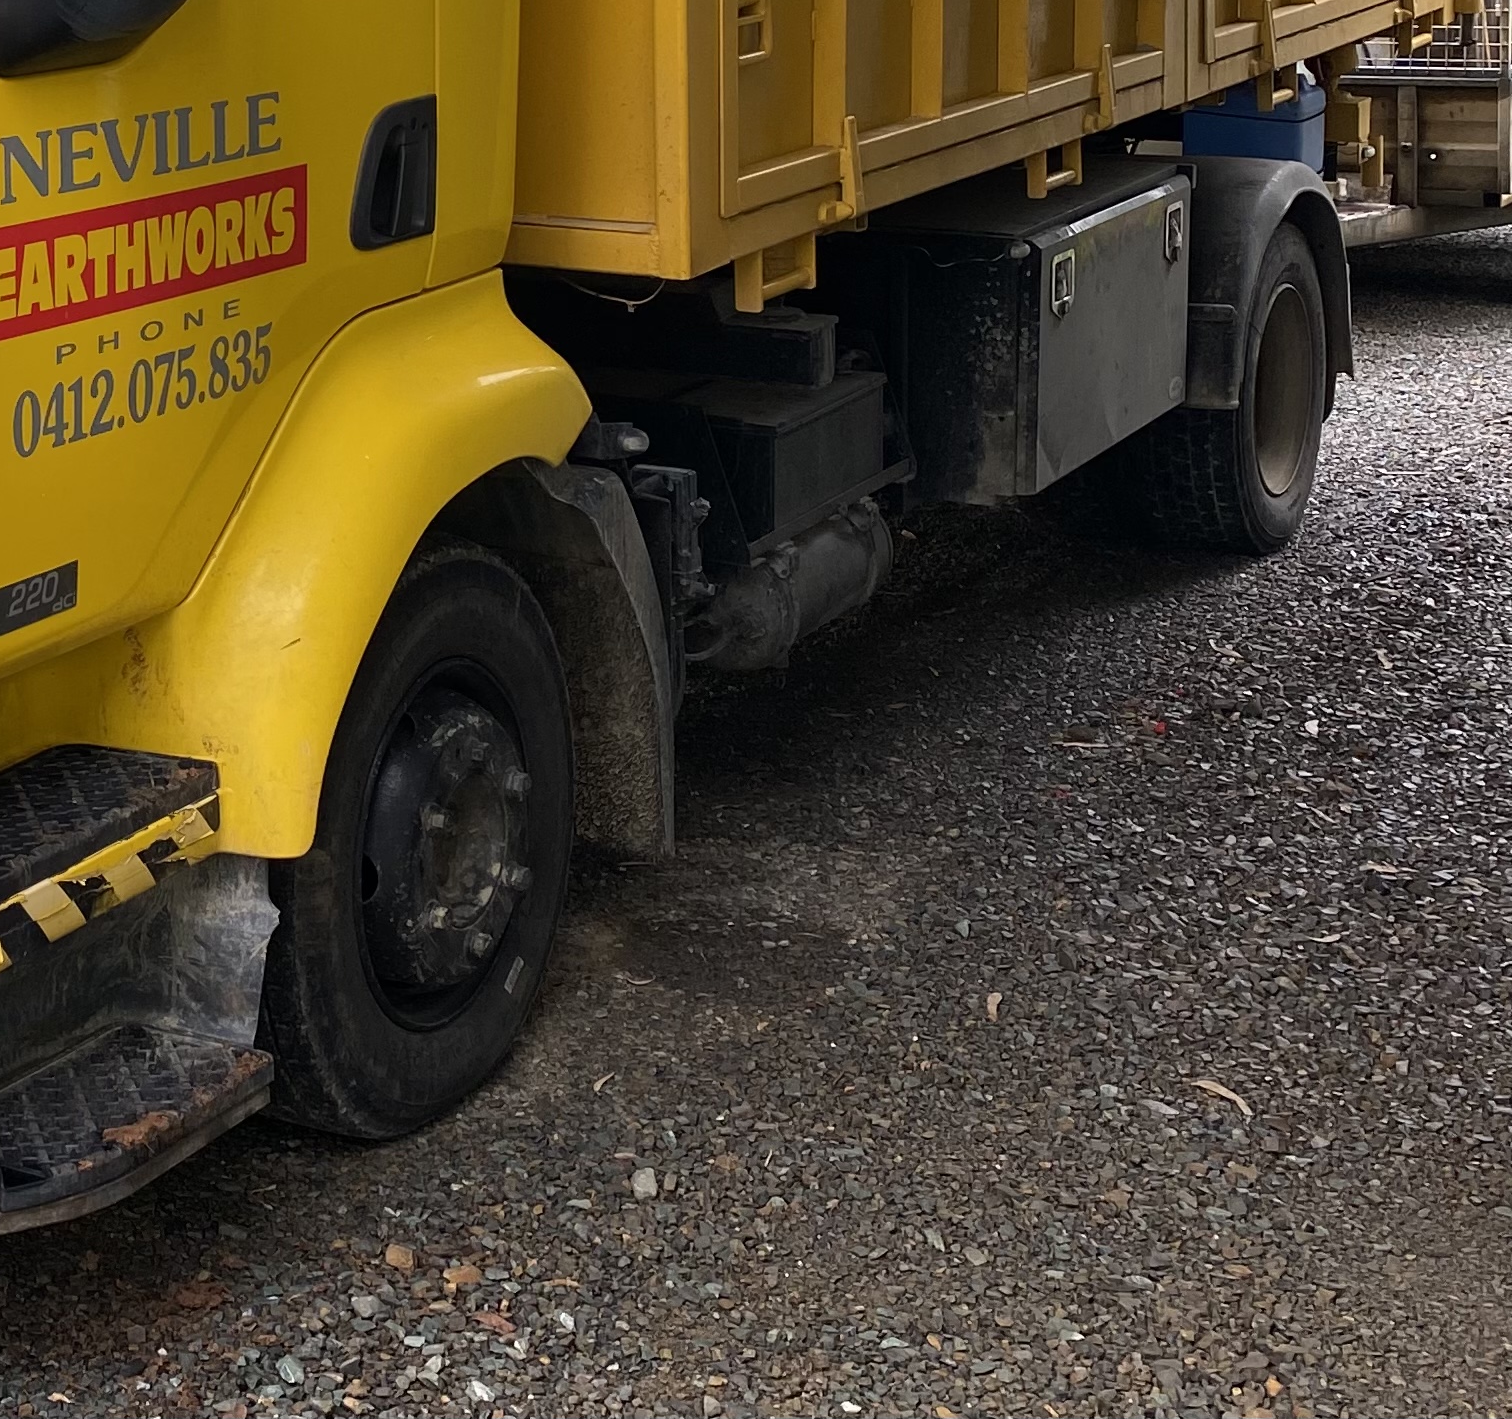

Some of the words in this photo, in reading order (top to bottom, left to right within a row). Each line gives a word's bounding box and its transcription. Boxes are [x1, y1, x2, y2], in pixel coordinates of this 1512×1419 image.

[56, 298, 241, 365] PHONE
[12, 322, 273, 458] 0412.075.835
[7, 571, 59, 618] 220
[52, 592, 76, 613] dCi
